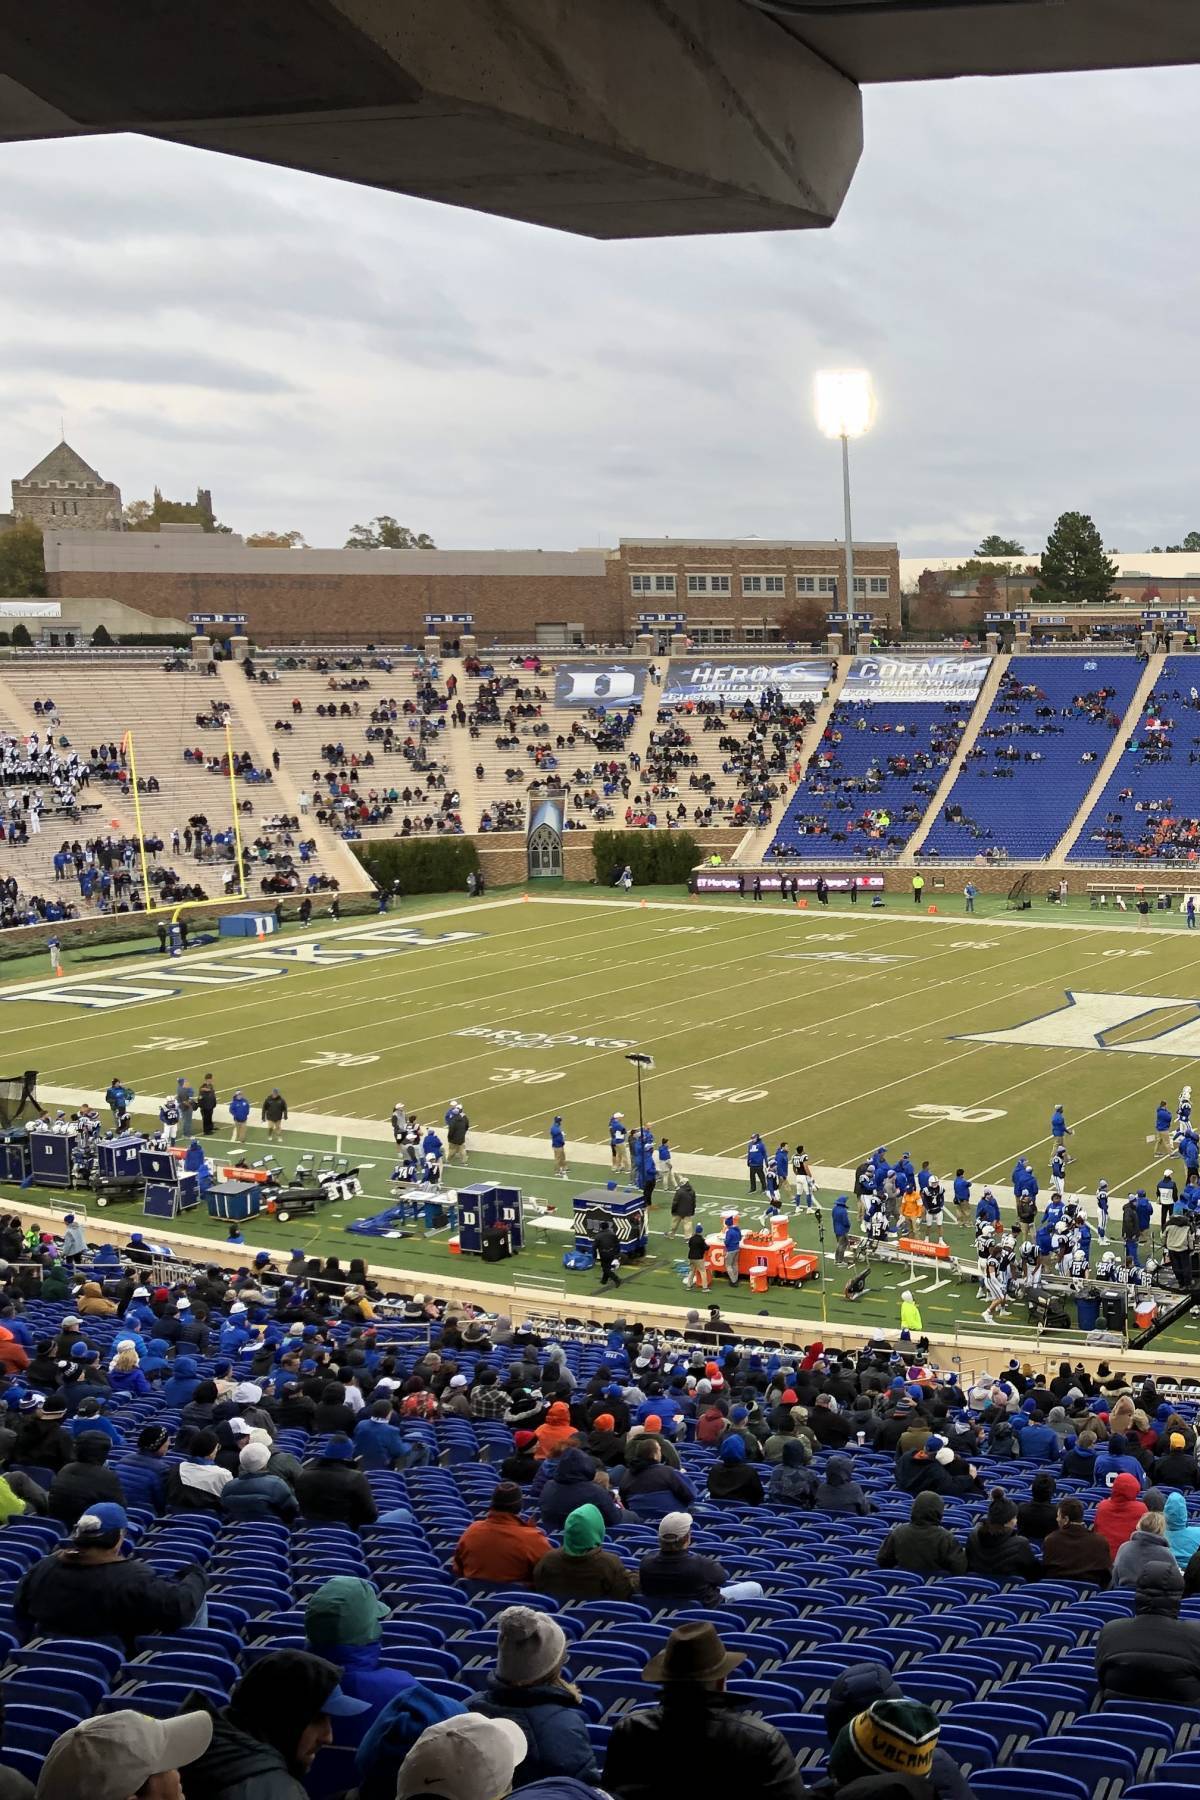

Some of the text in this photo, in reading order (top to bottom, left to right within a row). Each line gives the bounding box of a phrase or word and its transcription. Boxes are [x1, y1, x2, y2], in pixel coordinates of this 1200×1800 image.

[690, 667, 806, 683] HEROES
[859, 662, 977, 680] CORNER
[698, 682, 792, 692] Military &
[868, 679, 955, 688] Thank You
[843, 688, 866, 697] For
[805, 932, 860, 941] 20
[949, 940, 1001, 950] 30
[1101, 948, 1155, 958] 40
[0, 926, 488, 1008] DUKE
[132, 1035, 209, 1051] 10
[450, 1027, 638, 1049] BROOKS
[300, 1051, 381, 1067] 20
[488, 1070, 567, 1085] 30
[692, 1087, 768, 1104] 40
[872, 1225, 881, 1236] 15
[710, 1248, 725, 1267] G
[1072, 1265, 1081, 1276] 12
[1096, 1264, 1106, 1276] 22
